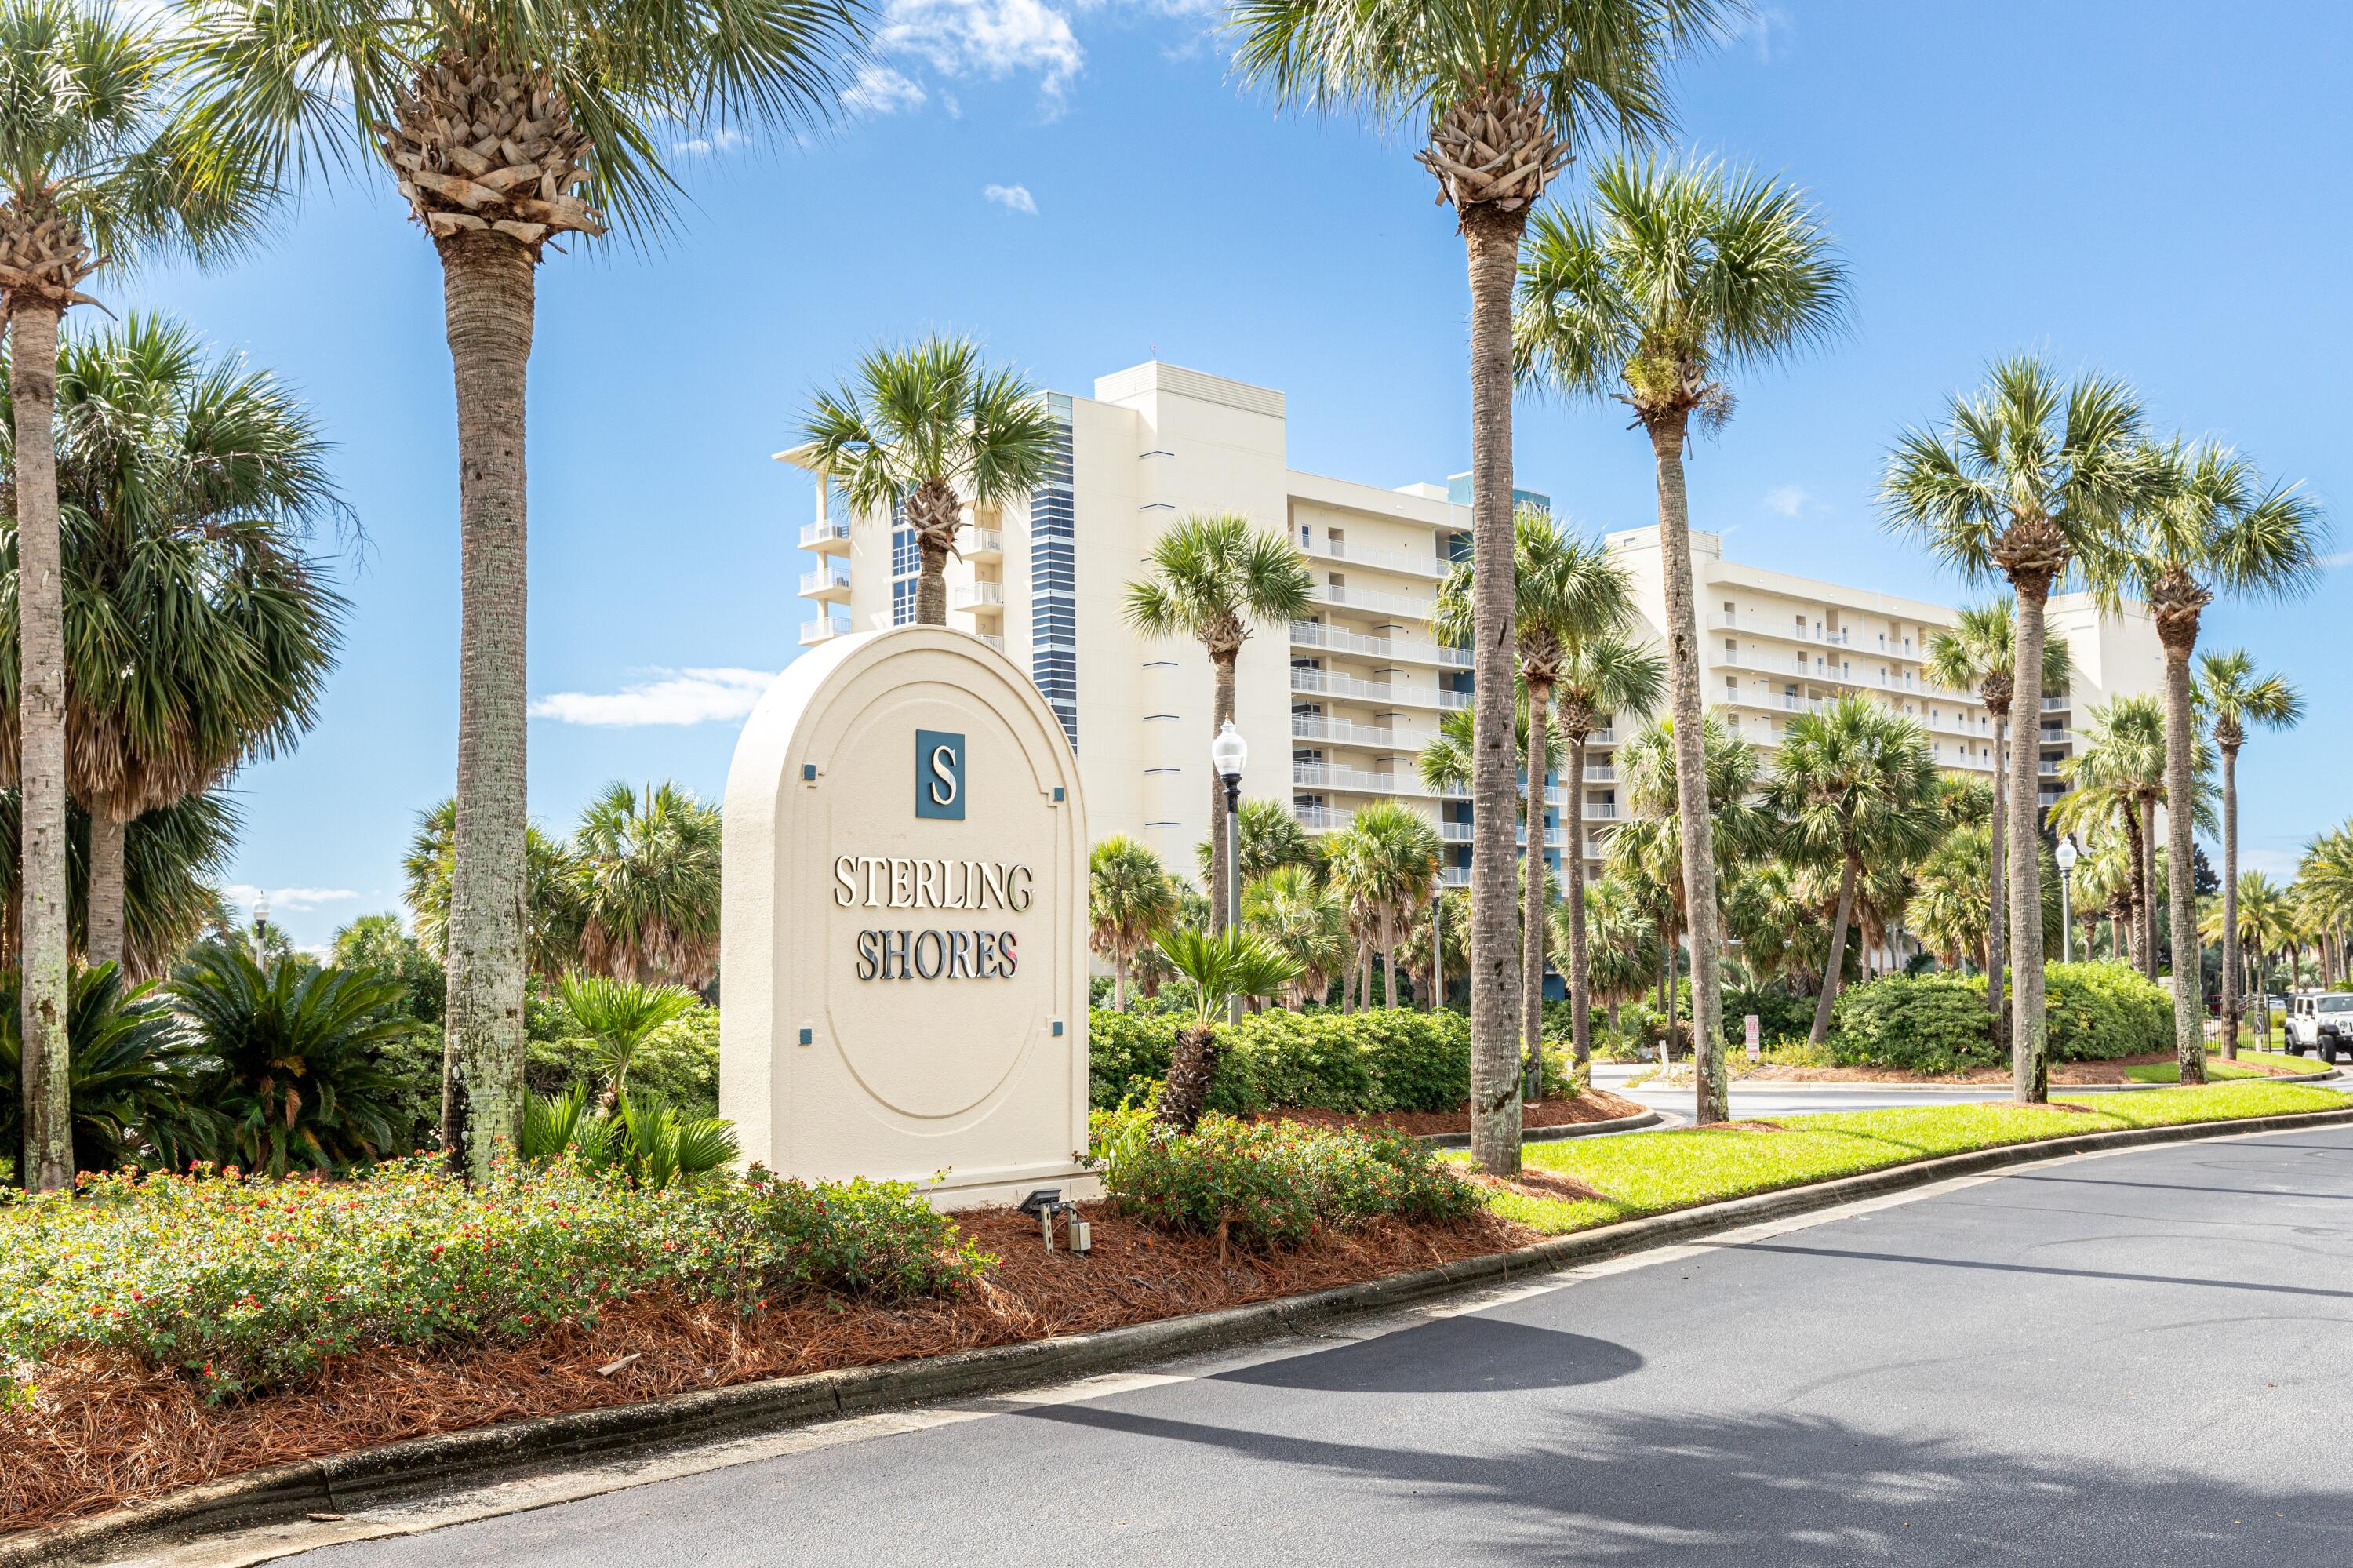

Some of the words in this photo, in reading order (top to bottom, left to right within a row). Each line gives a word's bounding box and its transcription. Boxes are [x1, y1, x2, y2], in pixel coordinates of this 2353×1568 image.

[930, 745, 957, 805] S
[835, 855, 1035, 911] STERLING
[856, 930, 1018, 980] SHORES
